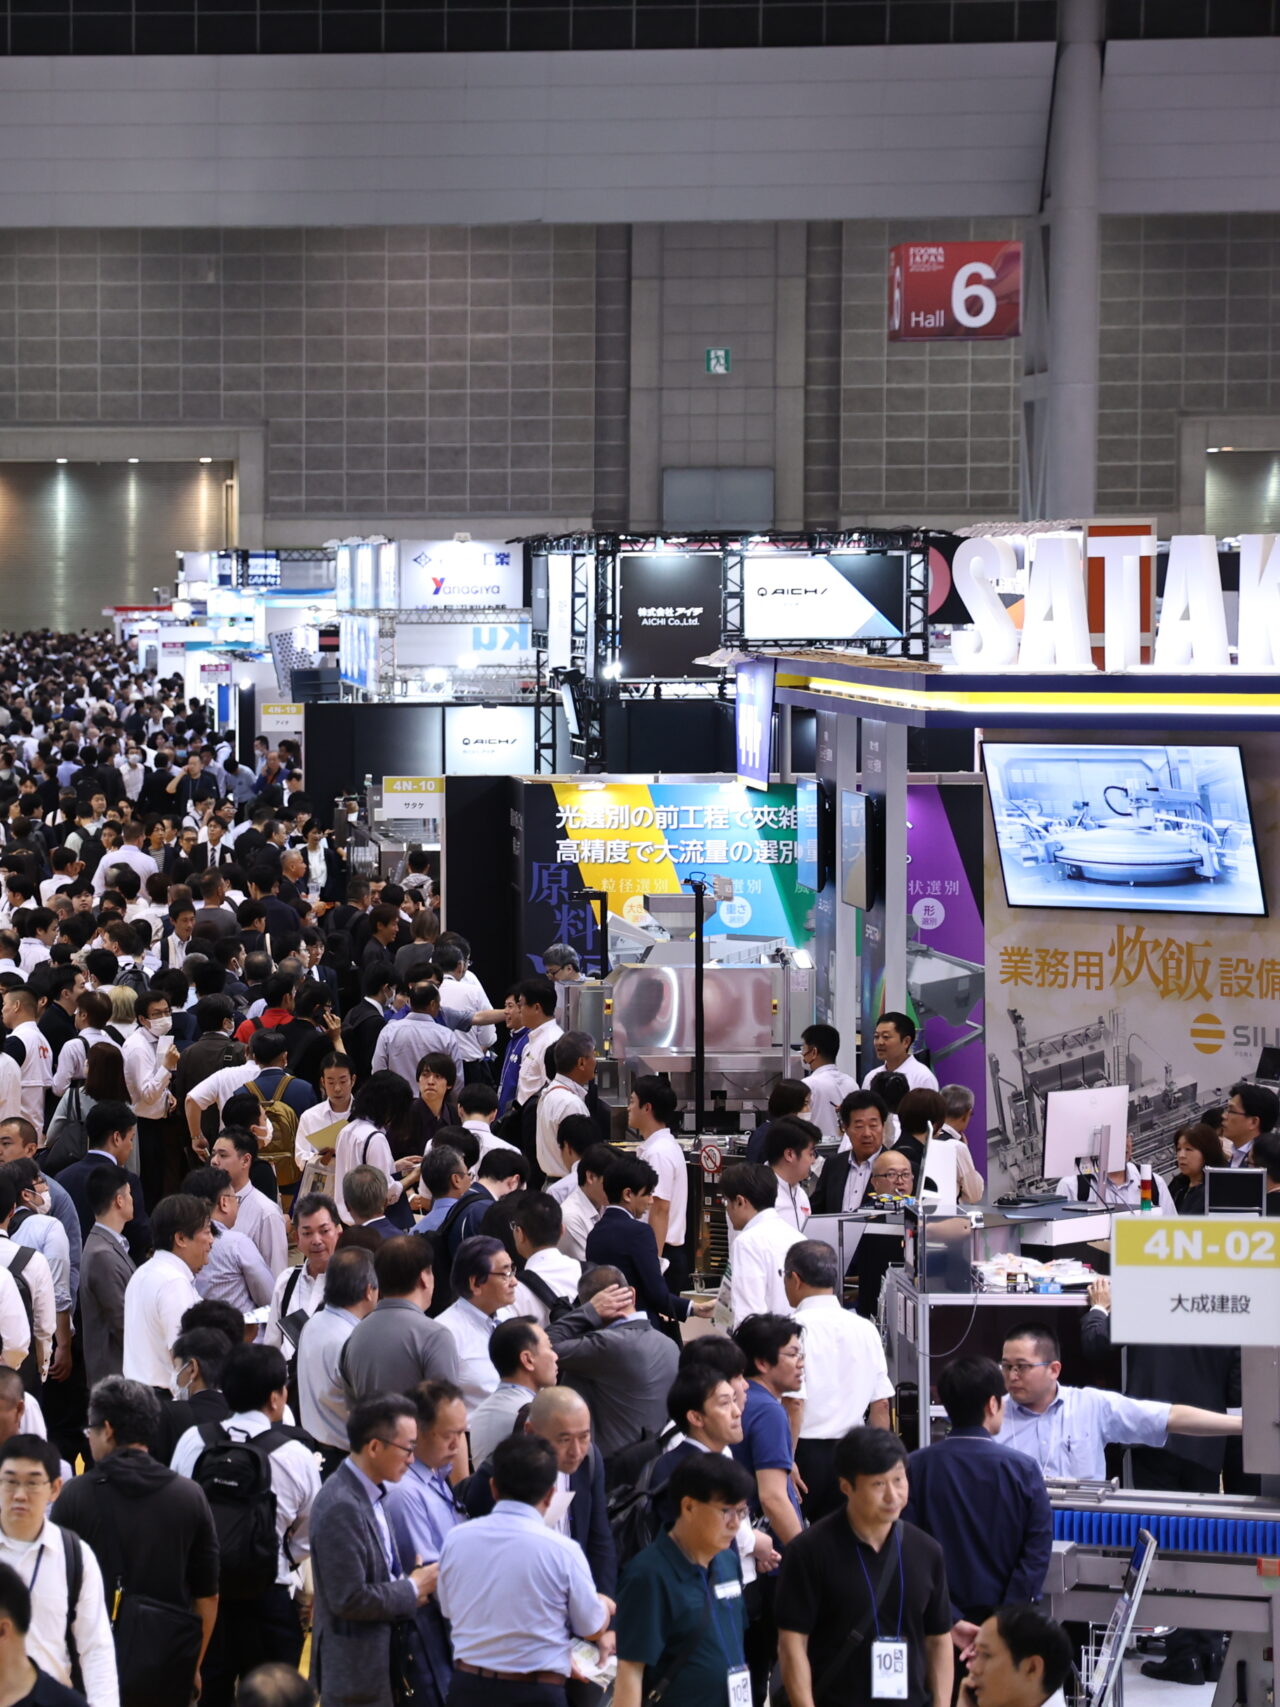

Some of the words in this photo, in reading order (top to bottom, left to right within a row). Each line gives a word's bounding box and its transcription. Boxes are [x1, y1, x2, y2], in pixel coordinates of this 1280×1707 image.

[909, 254, 945, 266] JAPAN
[910, 309, 945, 328] Hall
[951, 261, 997, 328] 6
[641, 617, 666, 626] AICHI
[392, 780, 436, 791] 4N-10
[404, 801, 425, 809] サタケ
[1143, 1229, 1275, 1261] 4N-02
[1170, 1293, 1251, 1314] 大成建設
[876, 1652, 893, 1671] 10
[731, 1684, 743, 1702] 10
